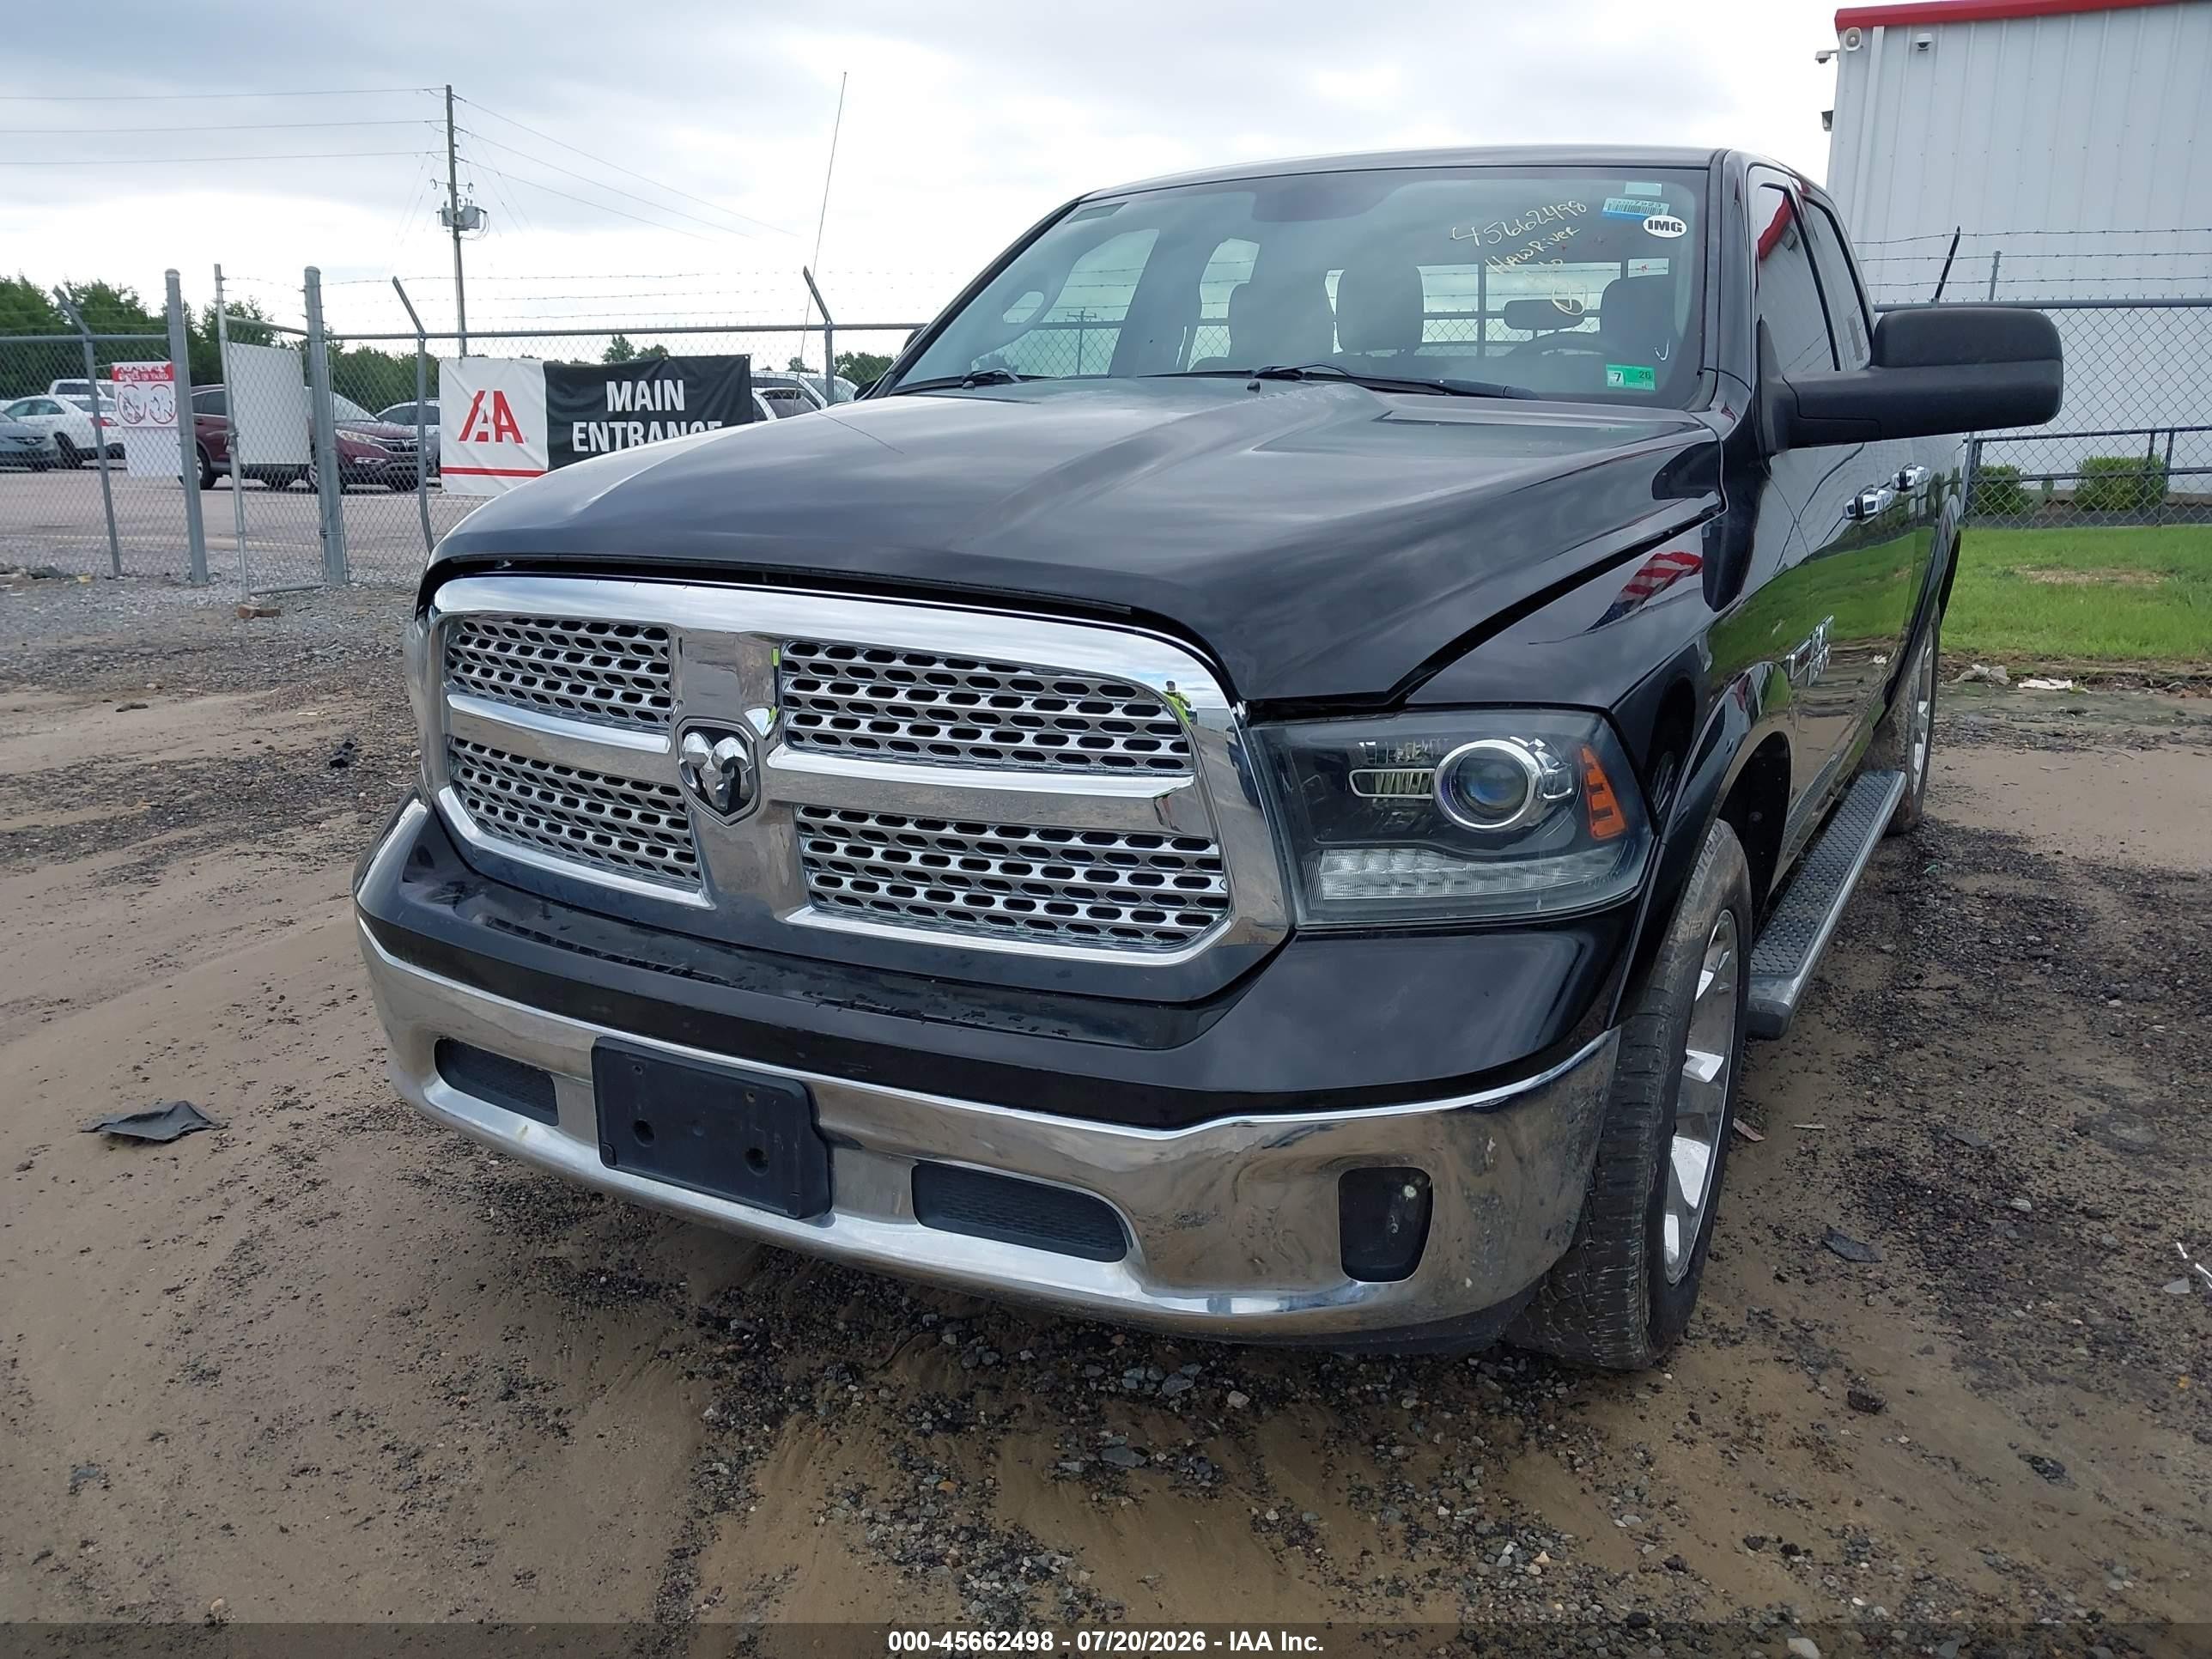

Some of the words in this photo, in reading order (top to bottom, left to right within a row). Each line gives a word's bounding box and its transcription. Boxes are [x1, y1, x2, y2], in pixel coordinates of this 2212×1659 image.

[1451, 200, 1587, 246] 45662498
[1648, 220, 1683, 233] IMG
[1614, 373, 1621, 382] 7
[606, 380, 685, 412] MAIN
